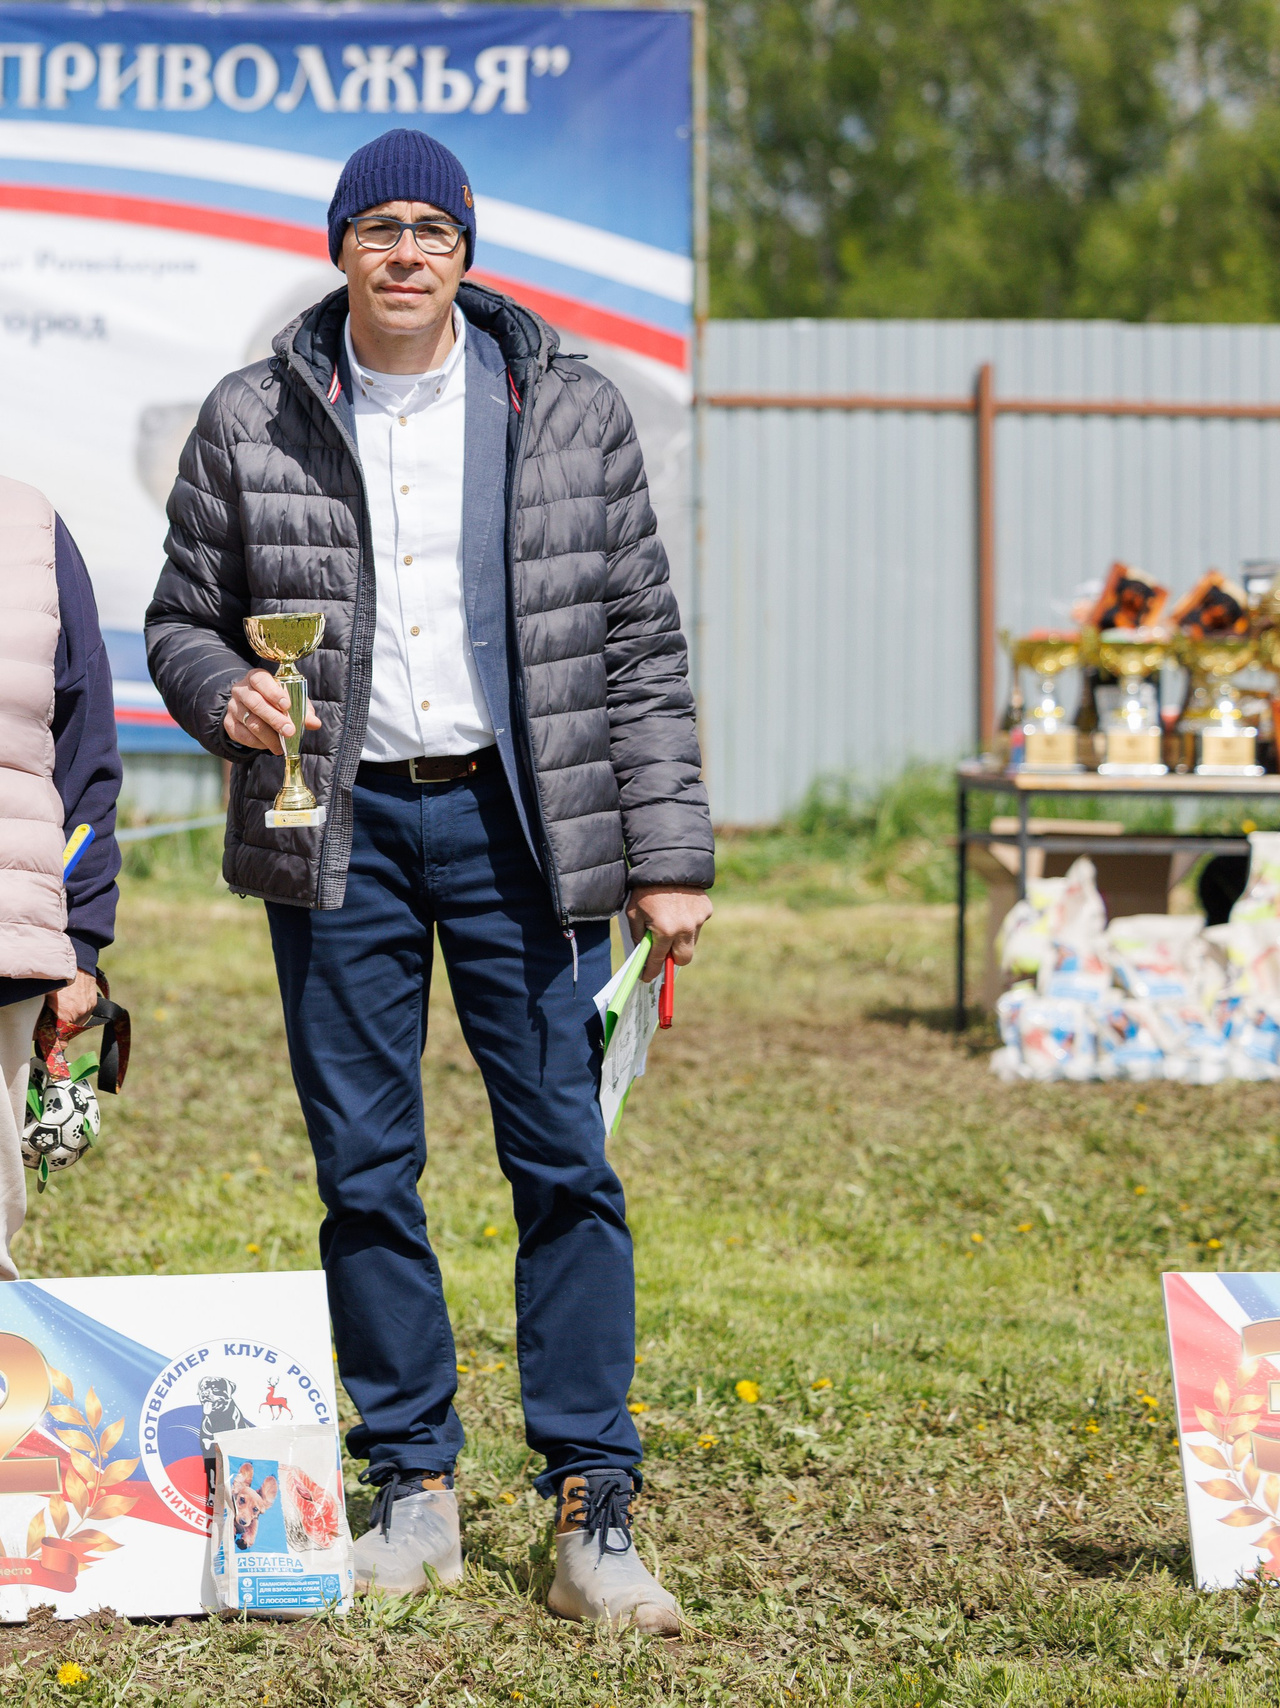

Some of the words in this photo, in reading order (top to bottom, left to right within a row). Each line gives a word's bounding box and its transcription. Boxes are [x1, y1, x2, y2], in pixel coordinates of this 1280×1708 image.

[144, 1348, 210, 1455] РОТВЕЙЛЕР
[224, 1343, 278, 1364] КЛУБ
[161, 1485, 213, 1529] НИЖЕГ
[248, 1556, 303, 1567] STATERA
